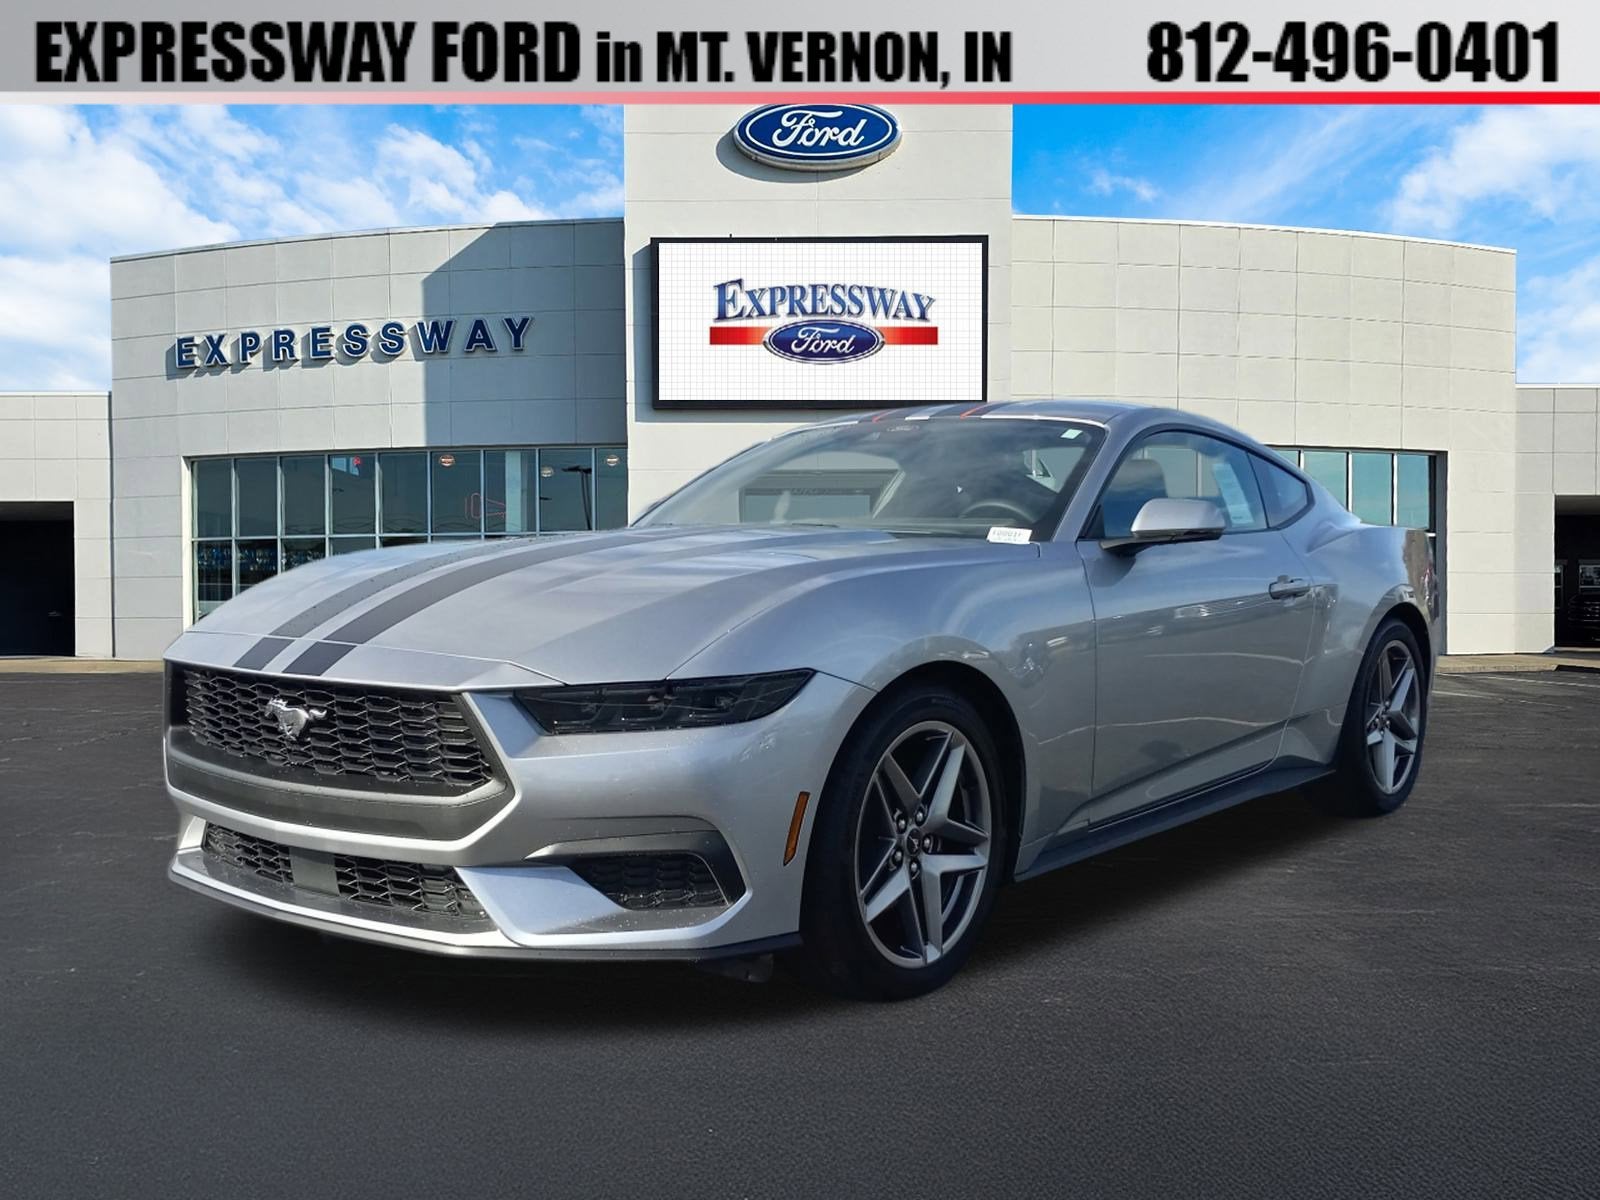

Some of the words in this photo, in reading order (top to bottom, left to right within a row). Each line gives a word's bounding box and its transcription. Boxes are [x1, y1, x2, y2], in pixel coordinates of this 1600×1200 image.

[772, 109, 868, 148] Ford
[174, 314, 535, 369] EXPRESSWAY
[791, 326, 856, 355] Ford
